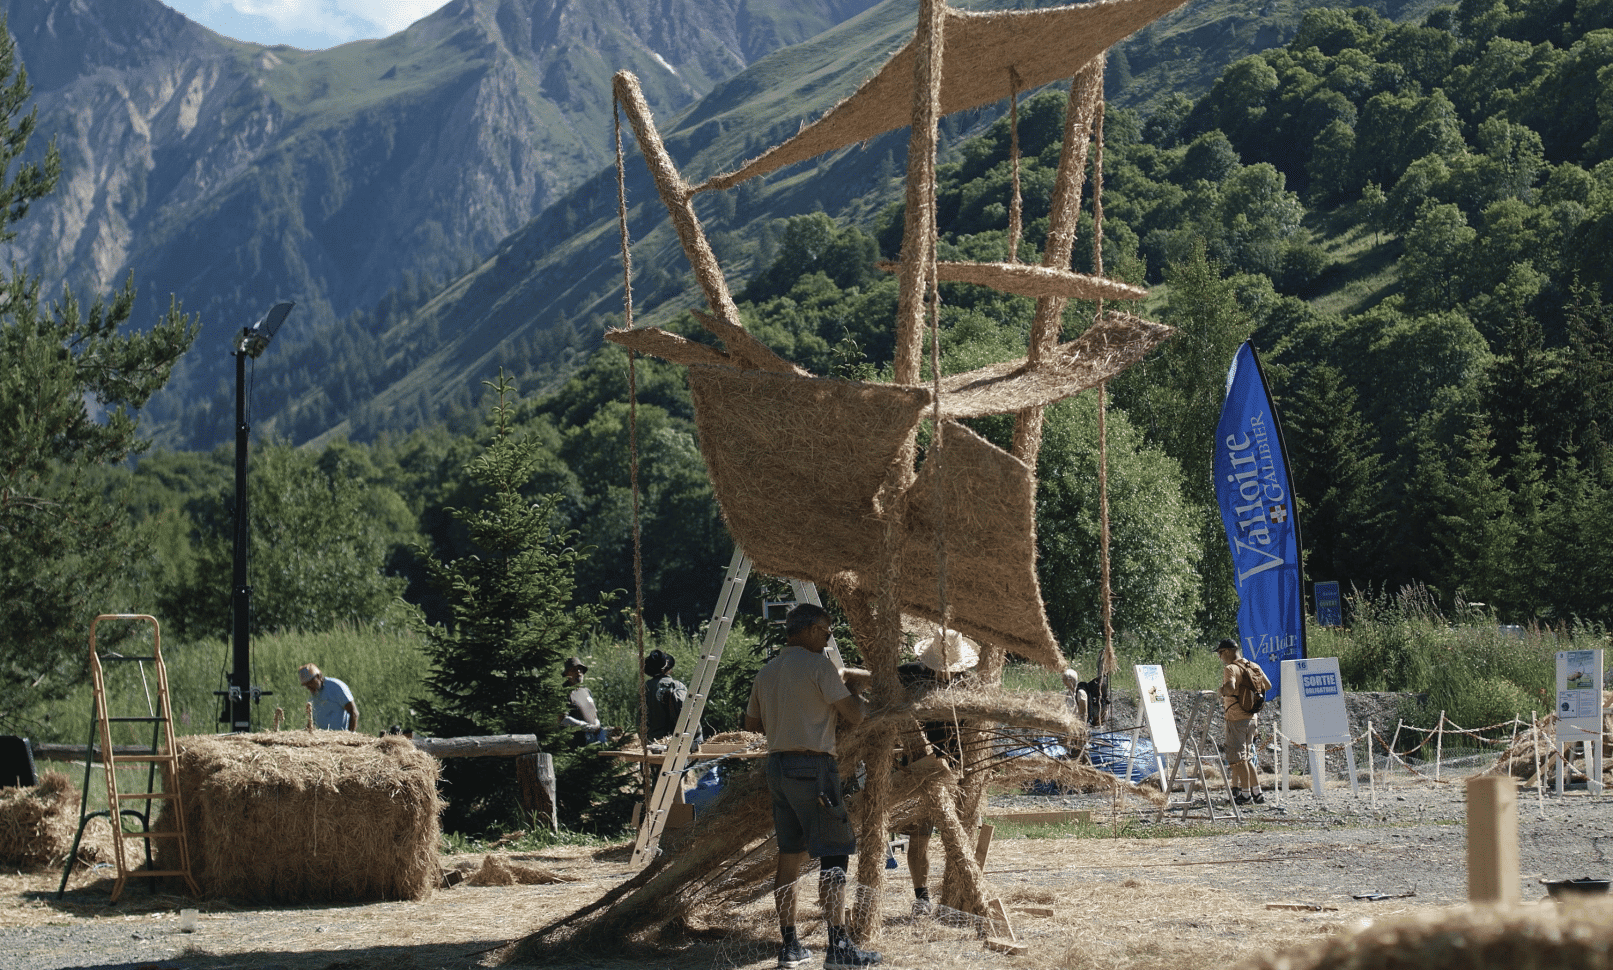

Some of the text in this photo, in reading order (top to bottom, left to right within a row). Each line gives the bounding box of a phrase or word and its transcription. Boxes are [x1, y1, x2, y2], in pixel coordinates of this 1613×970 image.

[1251, 410, 1284, 502] GALIBIER
[1226, 432, 1284, 587] Valloire
[1245, 632, 1298, 661] Valloir
[1297, 661, 1307, 669] 16
[1303, 674, 1335, 687] SORTIE
[1305, 686, 1337, 695] OBLIGATOIRE
